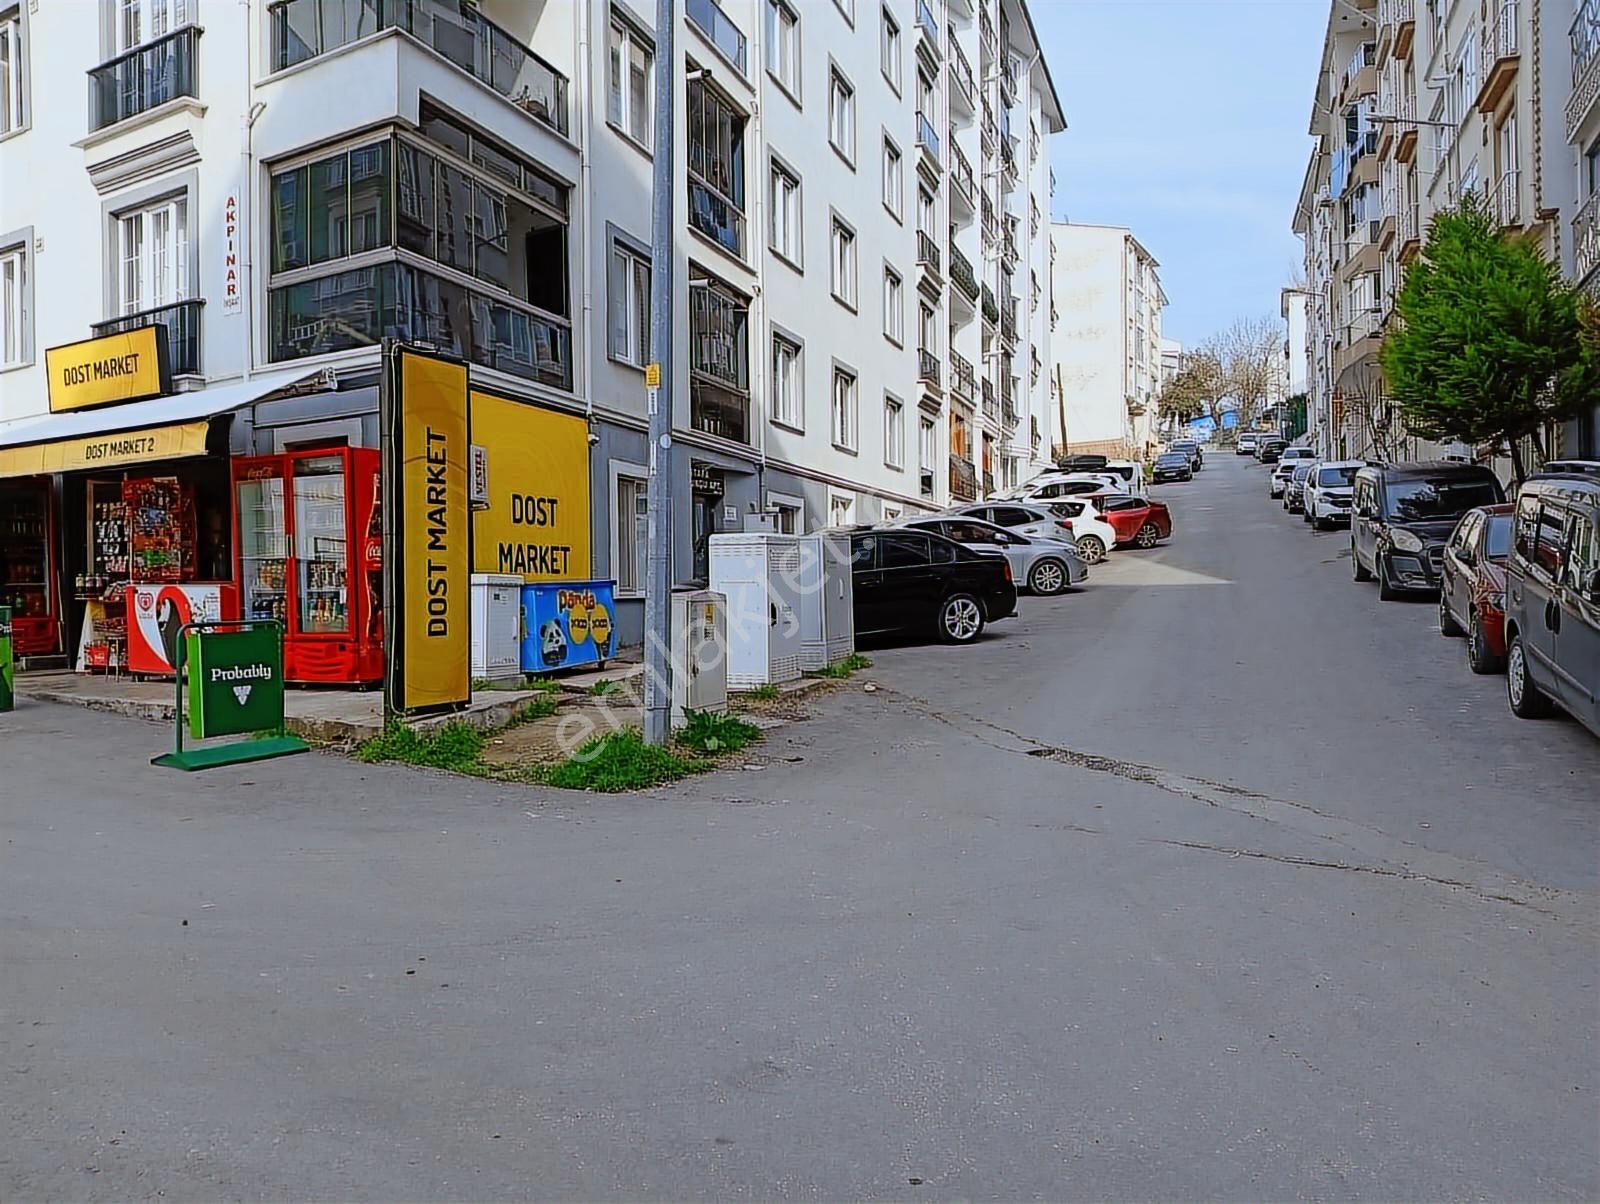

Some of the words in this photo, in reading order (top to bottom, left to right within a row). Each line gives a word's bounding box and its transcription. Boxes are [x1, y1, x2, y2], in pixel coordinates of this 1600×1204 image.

[226, 196, 236, 297] AKPINAR
[63, 364, 91, 387] DOST
[93, 353, 140, 381] MARKET
[86, 443, 108, 460] DOST
[109, 438, 147, 456] MARKET
[148, 437, 155, 452] 2
[426, 426, 447, 550] MARKET
[511, 493, 558, 527] DOST
[498, 542, 571, 576] MARKET
[427, 559, 448, 637] DOST
[211, 664, 272, 681] Probably
